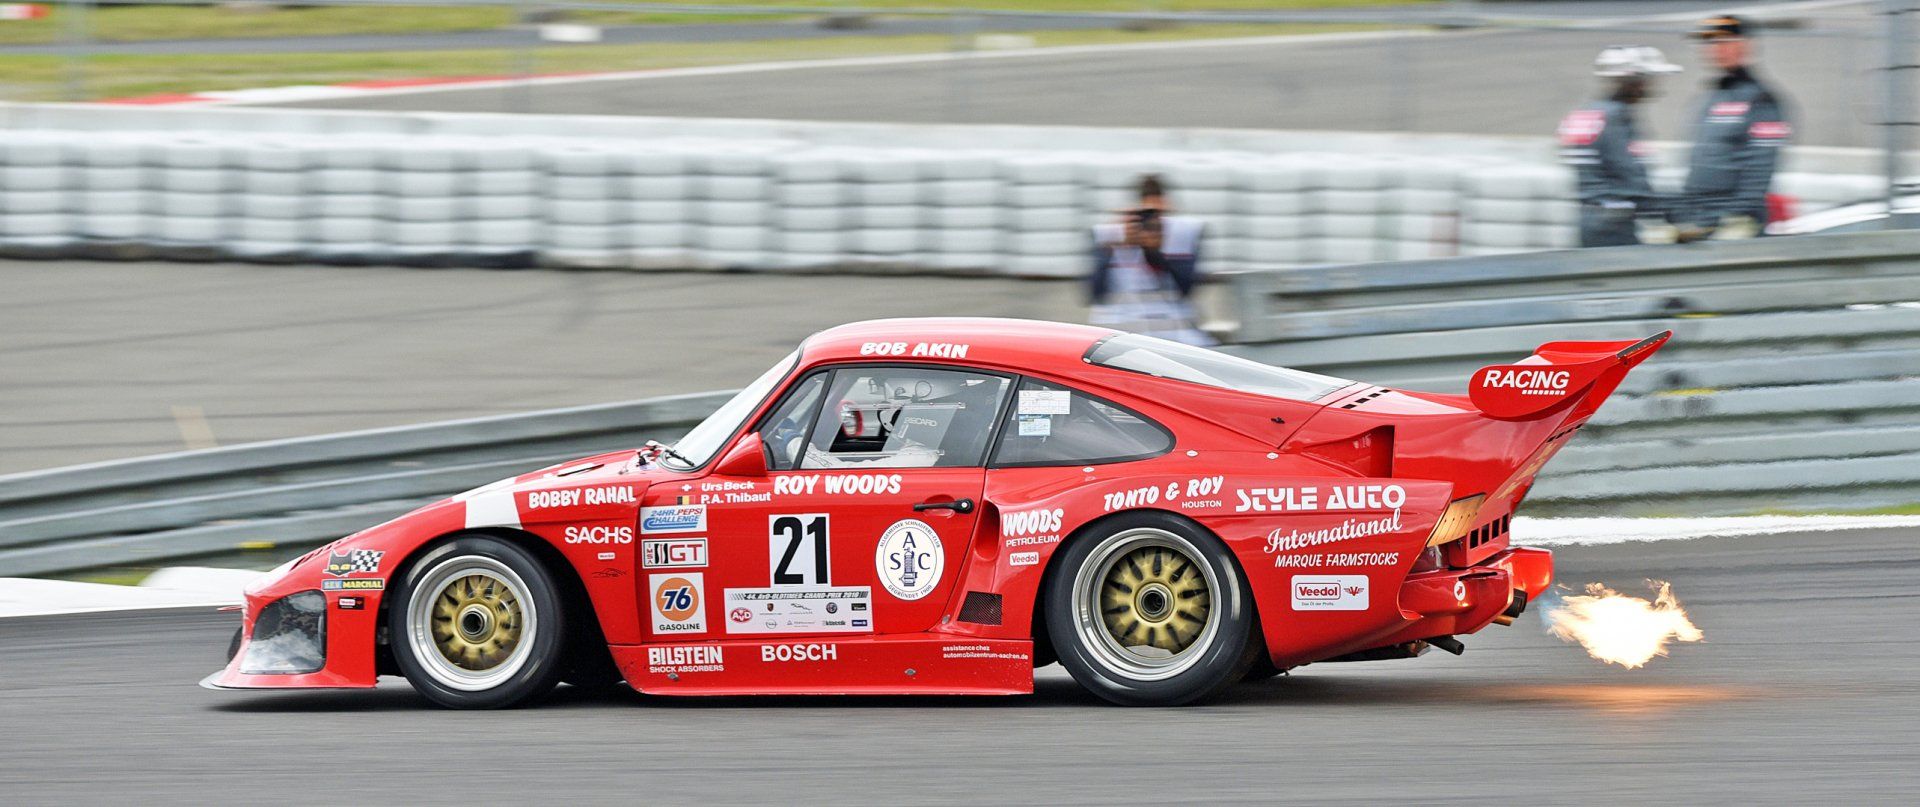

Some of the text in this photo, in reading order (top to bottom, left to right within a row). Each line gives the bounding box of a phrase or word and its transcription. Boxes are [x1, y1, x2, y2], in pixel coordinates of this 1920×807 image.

[860, 342, 970, 359] BOB AKIN
[1483, 370, 1570, 389] RACING
[701, 481, 755, 492] Urs Beck
[774, 474, 903, 495] ROY WOODS
[1103, 475, 1224, 511] TONTO & ROY
[528, 485, 637, 509] BOBBY RAHAL
[700, 491, 772, 504] P.A. Thibaut
[1181, 500, 1222, 510] HOUSTON
[1235, 484, 1406, 513] STYLE AUTO
[644, 514, 700, 526] CHALLENGE
[677, 507, 703, 516] PEPSI
[1002, 508, 1064, 537] WOODS
[1263, 508, 1403, 554] International
[564, 526, 633, 544] SACHS
[902, 531, 917, 548] A
[1006, 534, 1060, 547] PETROLEUM
[669, 544, 703, 562] GT
[773, 516, 828, 585] 21
[1011, 553, 1038, 564] Veedol
[1275, 552, 1399, 568] MARQUE FARMSTOCKS
[343, 580, 383, 589] MARCHAL
[1298, 586, 1338, 597] Veedol
[661, 586, 693, 612] 76
[659, 623, 700, 631] GASOLINE
[648, 645, 724, 665] BILSTEIN
[761, 643, 837, 662] BOSCH
[678, 665, 724, 673] ABSORBERS
